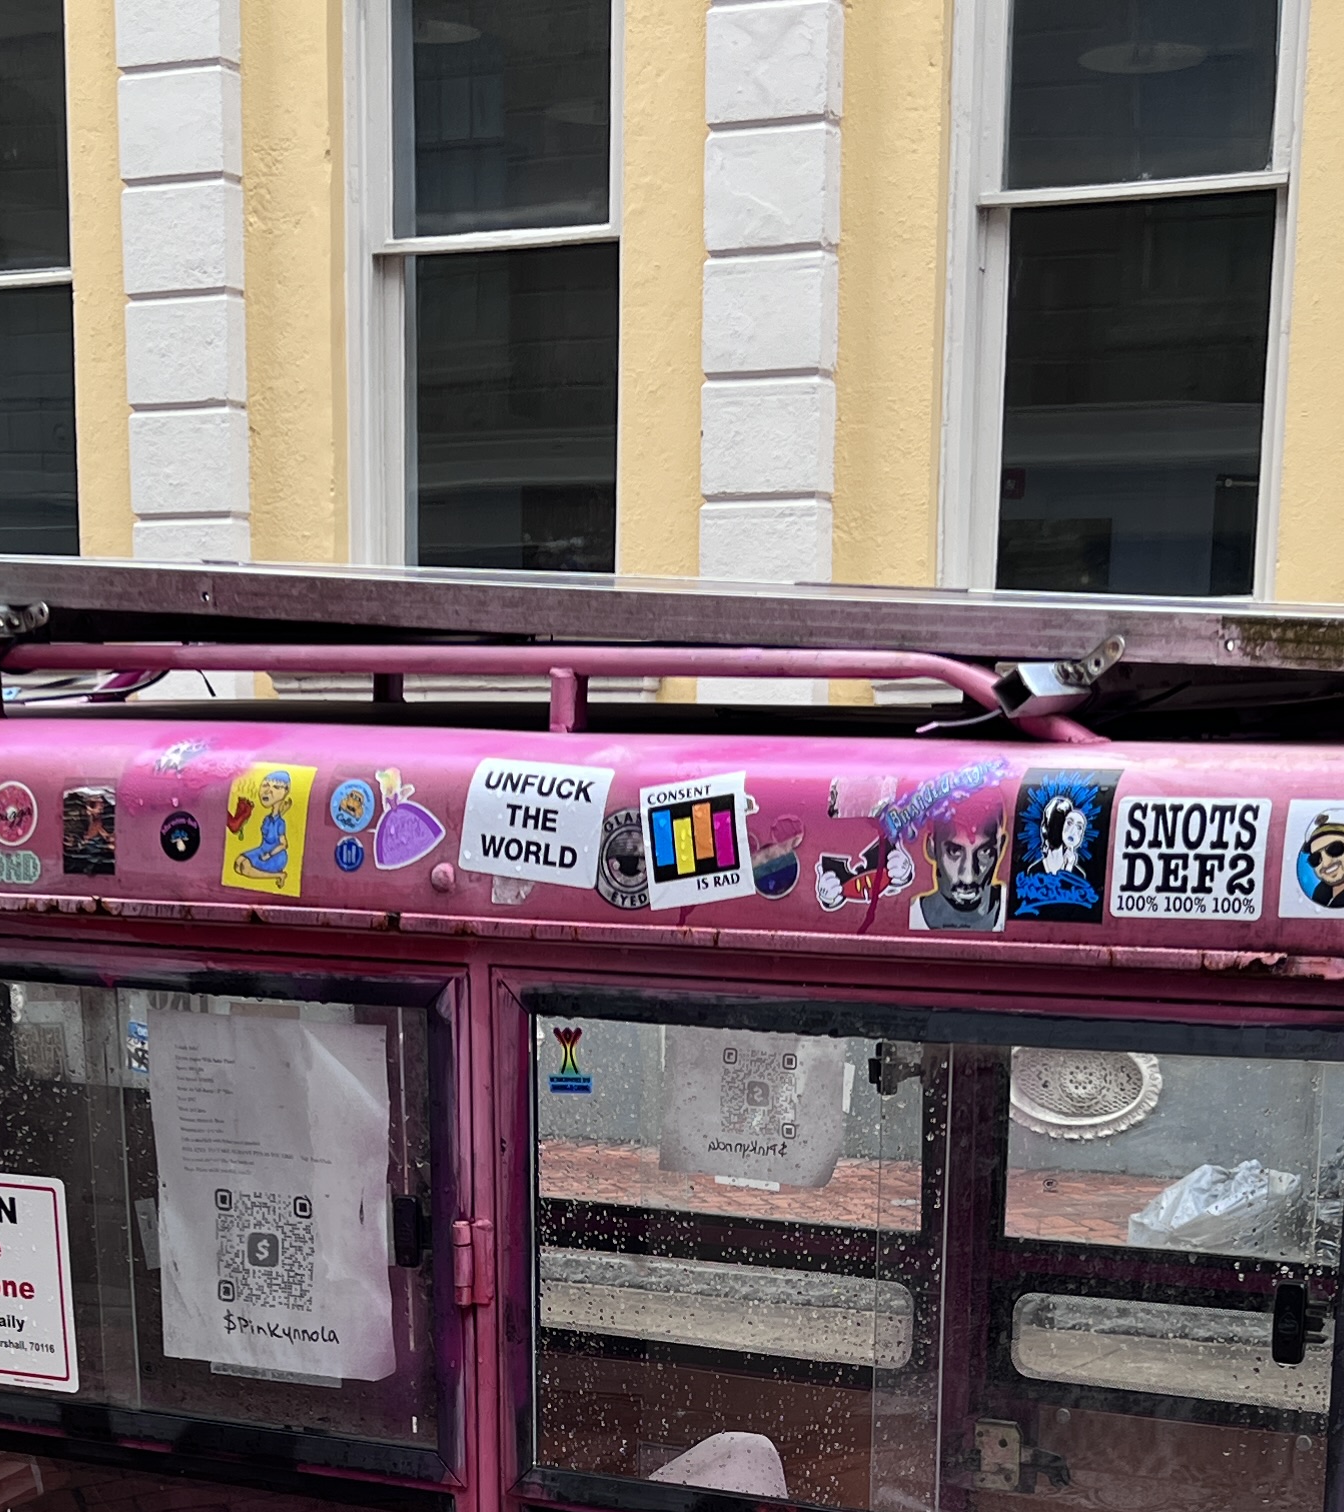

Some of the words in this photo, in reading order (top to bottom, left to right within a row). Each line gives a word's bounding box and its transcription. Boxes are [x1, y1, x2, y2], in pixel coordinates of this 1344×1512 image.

[484, 771, 596, 803] UNFUCK
[647, 784, 712, 805] CONSENT
[506, 803, 559, 833] THE
[1124, 802, 1261, 852] SNOTS
[480, 834, 578, 869] WORLD
[696, 876, 709, 891] IS
[713, 873, 741, 888] RAD
[610, 891, 648, 907] EYED
[1116, 895, 1159, 913] 100%
[1163, 895, 1207, 913] 100%
[1211, 896, 1256, 915] 100%
